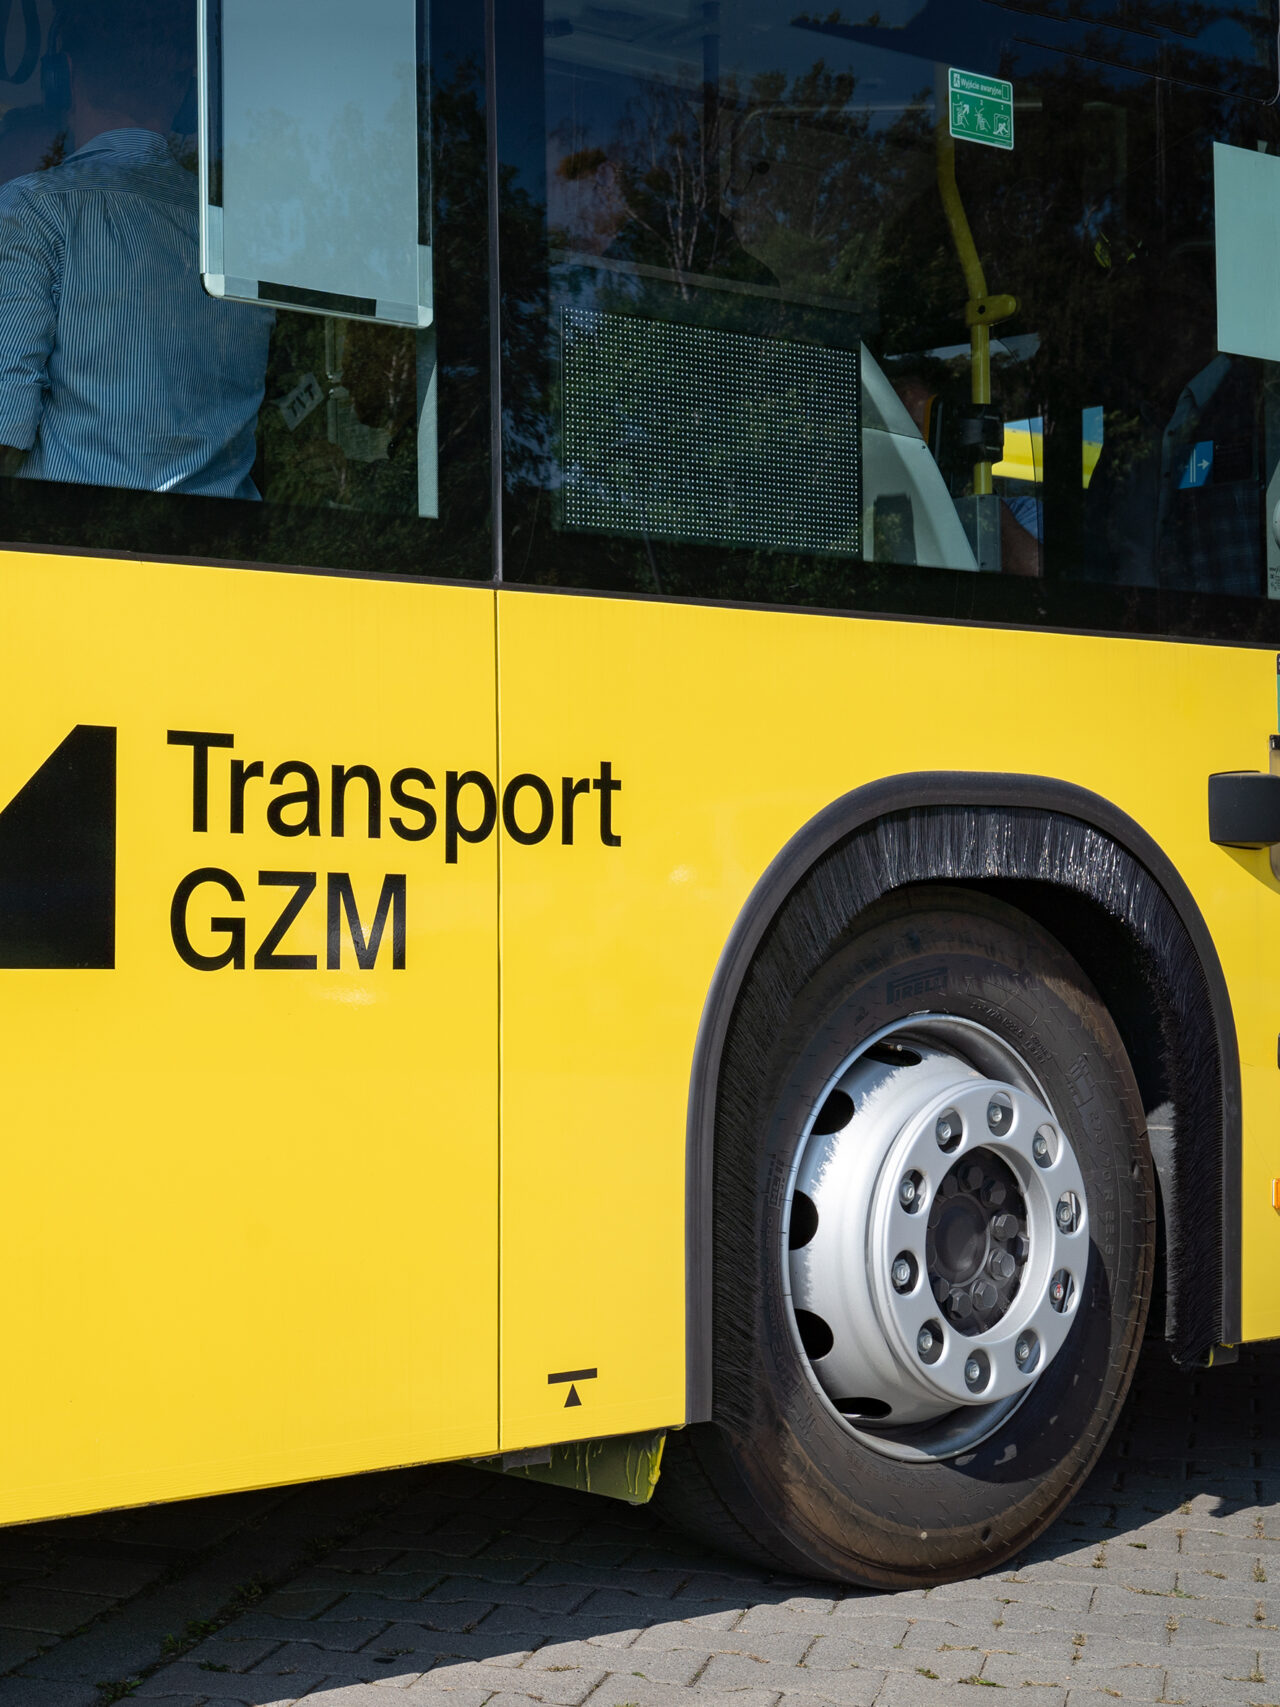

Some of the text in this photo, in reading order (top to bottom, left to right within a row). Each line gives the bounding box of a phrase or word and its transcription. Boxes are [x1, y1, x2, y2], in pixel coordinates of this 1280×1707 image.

[168, 730, 621, 863] Transport
[171, 868, 406, 971] GZM
[886, 966, 949, 1005] PIRELLI
